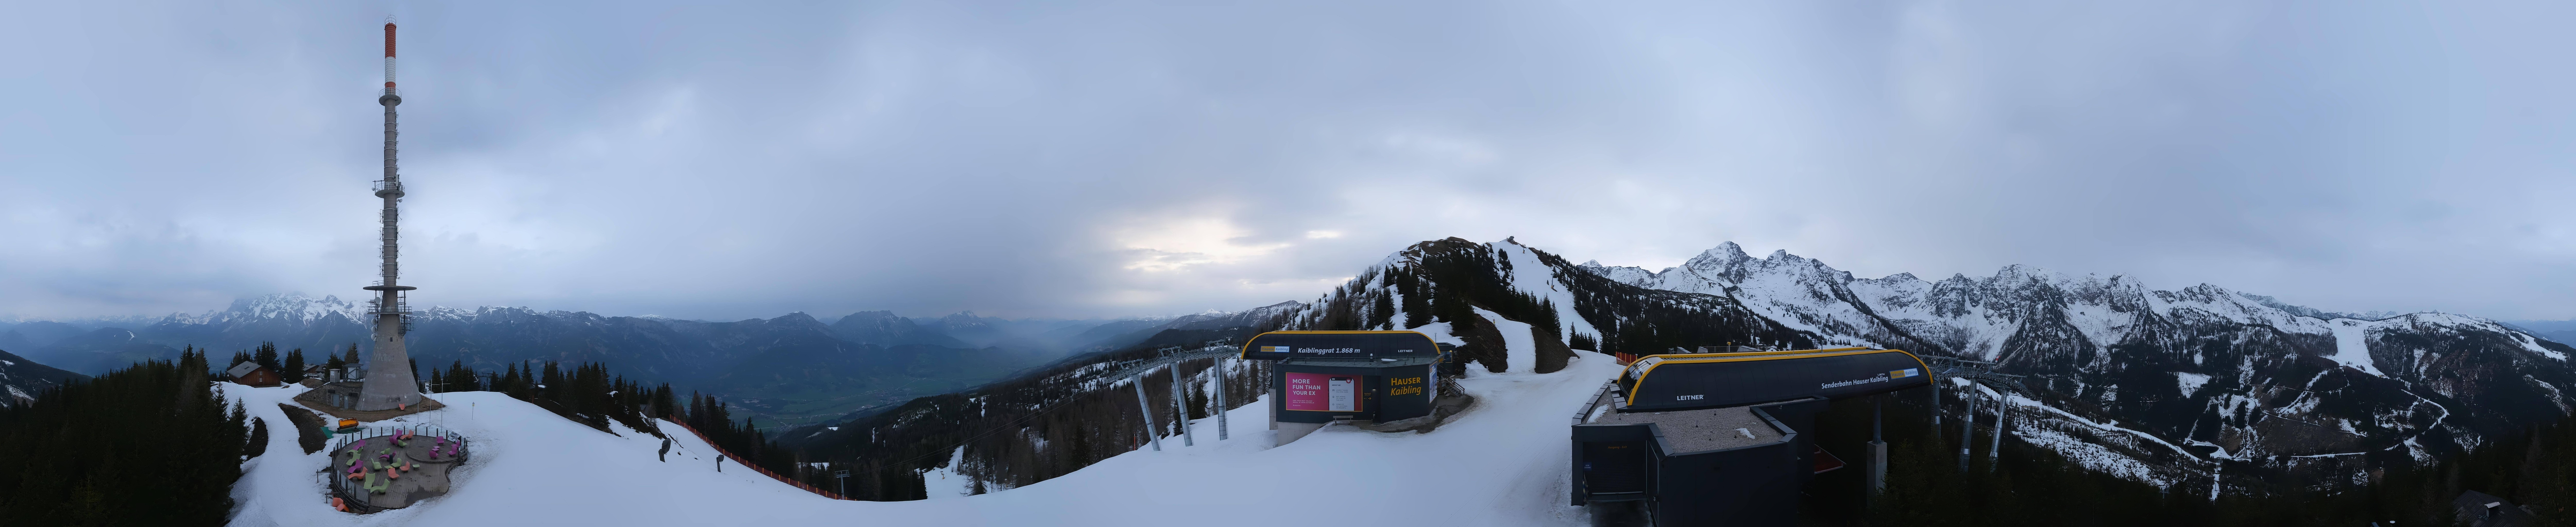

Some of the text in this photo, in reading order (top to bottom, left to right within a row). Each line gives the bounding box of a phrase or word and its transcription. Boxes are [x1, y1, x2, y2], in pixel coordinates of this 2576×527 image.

[1391, 377, 1421, 386] HAUSER
[1821, 380, 1852, 389] Senderbahn
[1391, 386, 1421, 396] Kaibling
